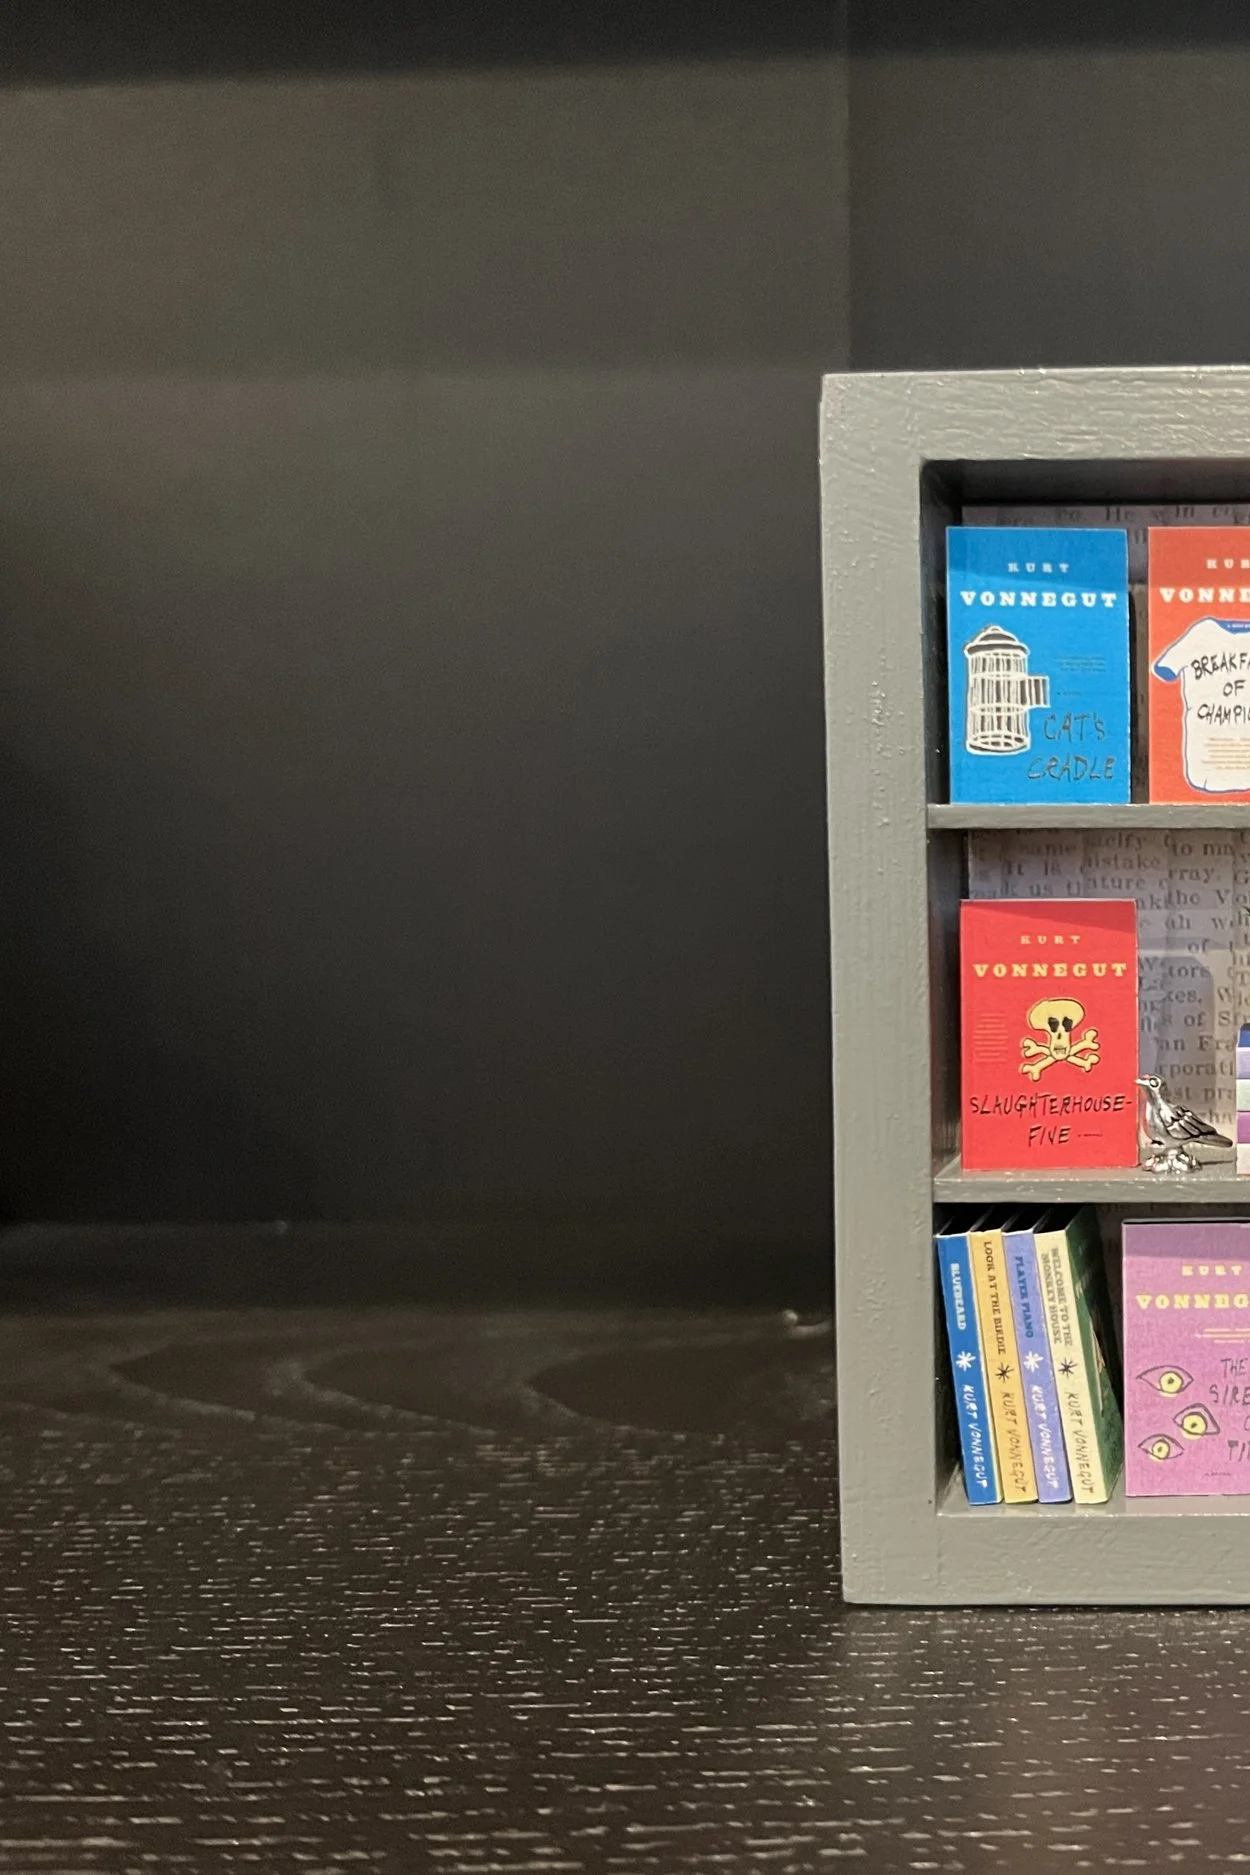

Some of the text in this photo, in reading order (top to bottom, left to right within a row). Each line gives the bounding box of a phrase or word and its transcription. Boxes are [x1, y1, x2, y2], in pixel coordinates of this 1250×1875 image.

[1007, 562, 1070, 574] KURT
[960, 590, 1118, 609] VONNEGUT
[1223, 679, 1246, 697] OF
[1027, 752, 1116, 782] CRADLE
[1020, 935, 1080, 945] KURT
[972, 963, 1129, 979] VONNEGUT
[969, 1092, 1133, 1119] SLAUGHTERHOUSE-
[1028, 1125, 1072, 1148] FIVE
[1181, 1265, 1243, 1276] KURT
[983, 1240, 1006, 1355] LOOK AT THE BIRDIE
[1014, 1255, 1034, 1338] PLAYER PIANO
[1059, 1305, 1069, 1322] TO
[1062, 1324, 1073, 1346] THE
[1220, 1357, 1248, 1379] THE
[961, 1384, 989, 1489] KURT VONNEGUT
[1000, 1391, 1027, 1493] KURT VONNEGUT
[1031, 1384, 1060, 1489] KURT VONNEGUT
[1065, 1391, 1095, 1494] KURT VONNEGUT
